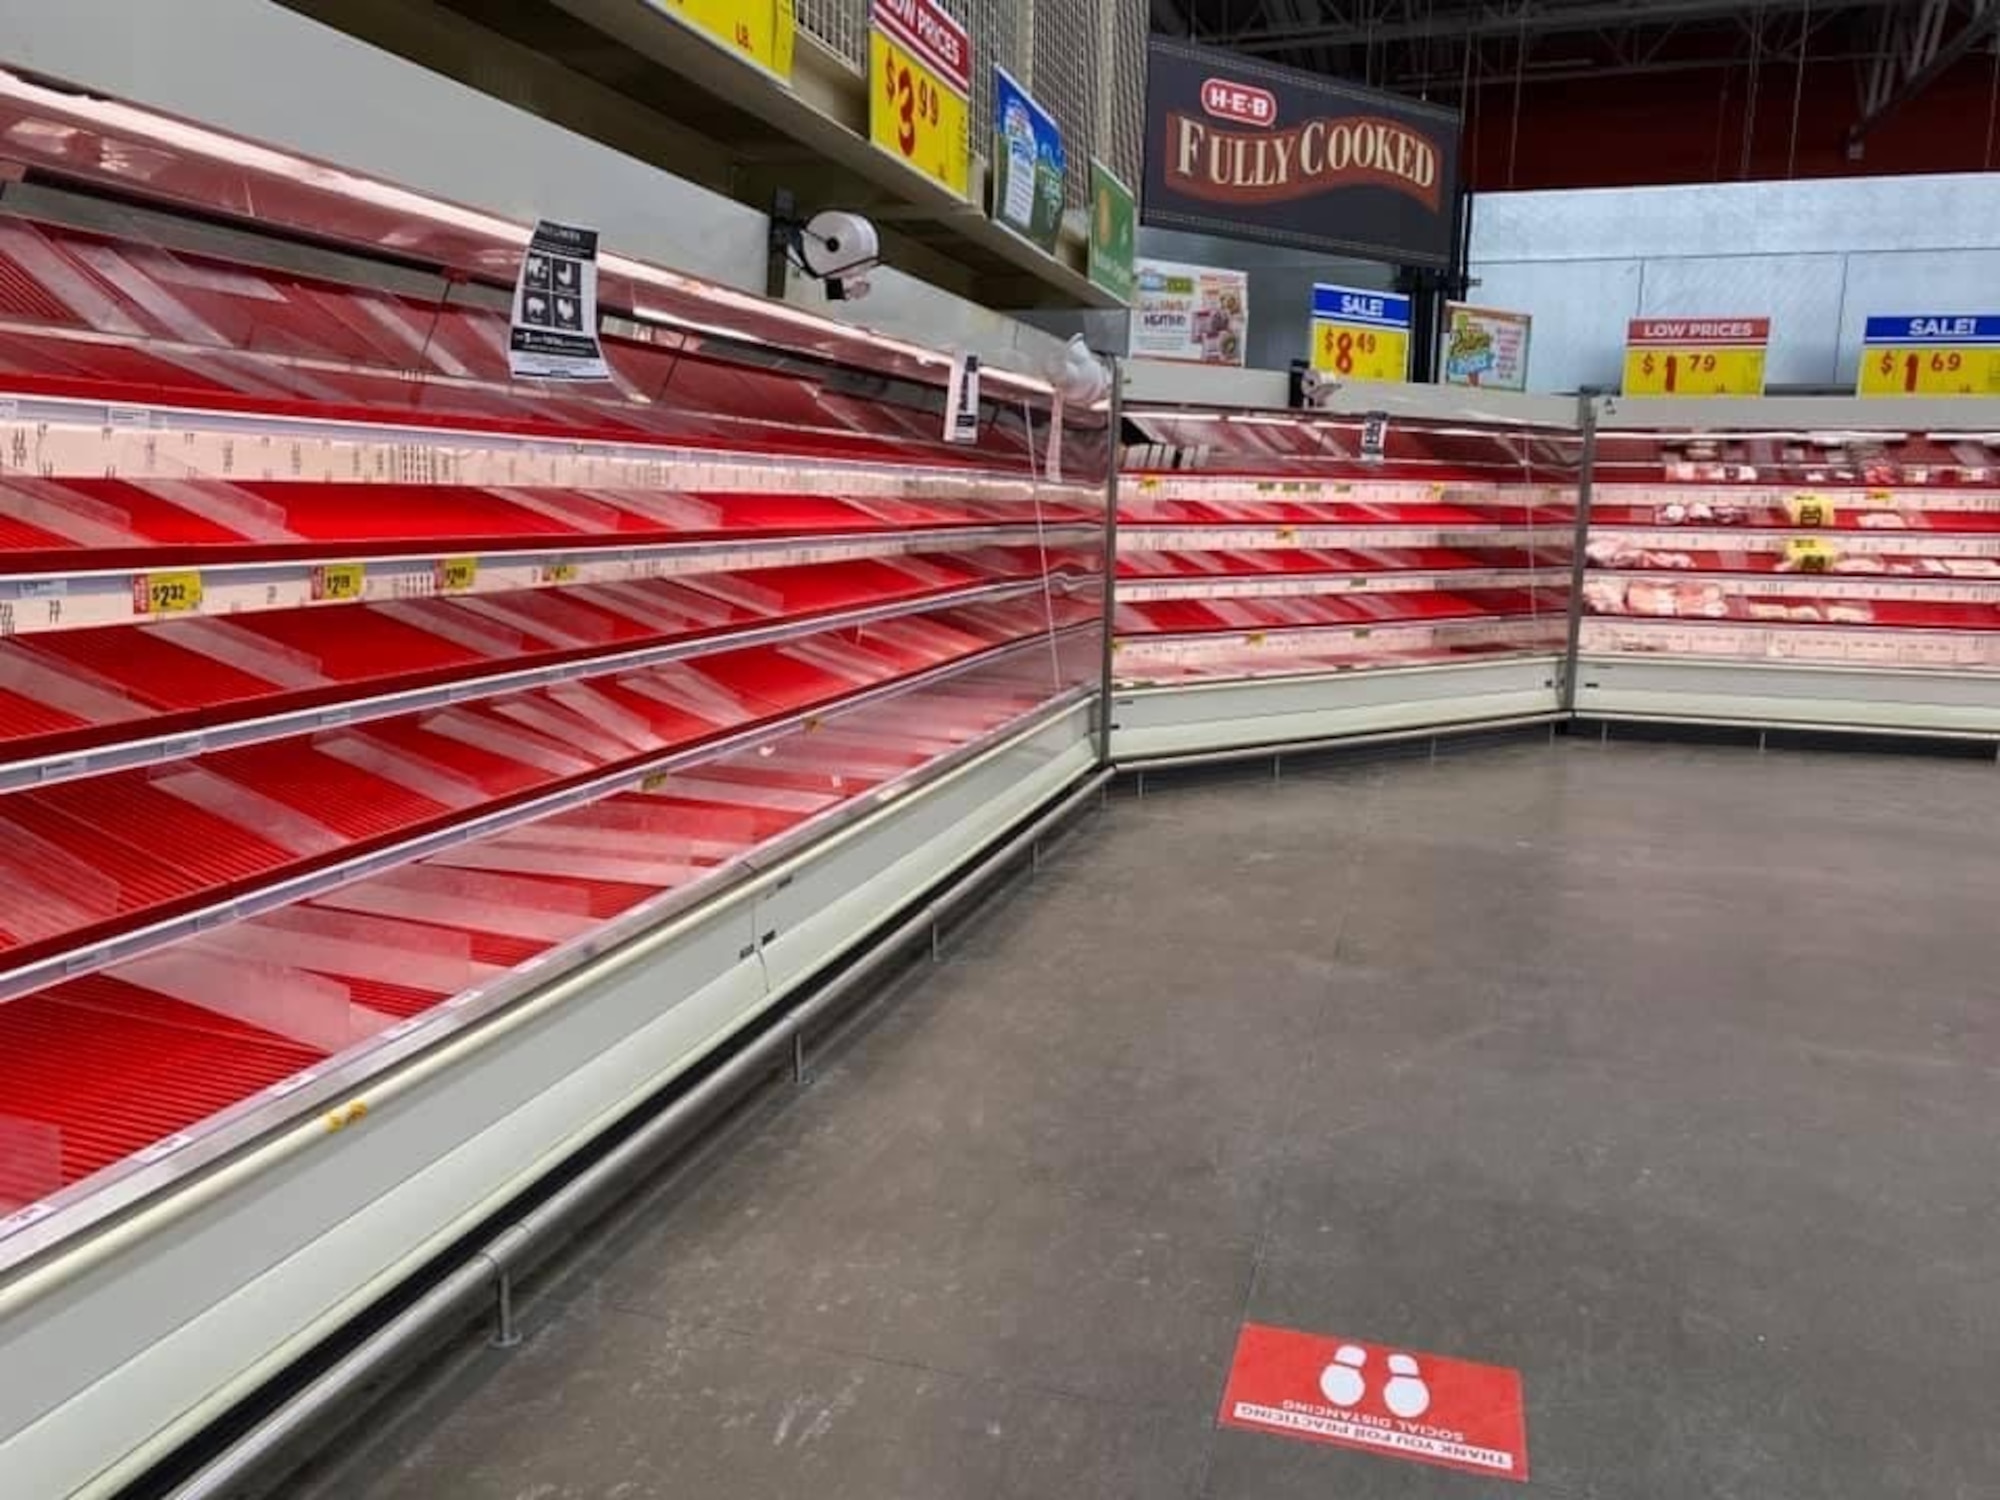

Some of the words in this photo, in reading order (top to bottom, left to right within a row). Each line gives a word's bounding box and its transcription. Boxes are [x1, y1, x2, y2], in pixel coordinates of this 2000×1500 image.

[886, 0, 917, 28] OW
[917, 7, 960, 66] PRICES
[1177, 116, 1296, 187] FULLY
[1300, 121, 1435, 188] COOKED
[1341, 294, 1385, 318] SALE!
[1643, 322, 1687, 337] LOW
[1689, 322, 1752, 337] PRICES
[1908, 318, 1977, 336] SALE!
[1241, 1404, 1350, 1435] PRACTICING
[1282, 1399, 1391, 1428] DISTANCING
[1353, 1429, 1392, 1443] FOR
[1396, 1420, 1464, 1443] SOCIAL
[1396, 1435, 1435, 1451] YOU
[1441, 1444, 1507, 1465] THANK
